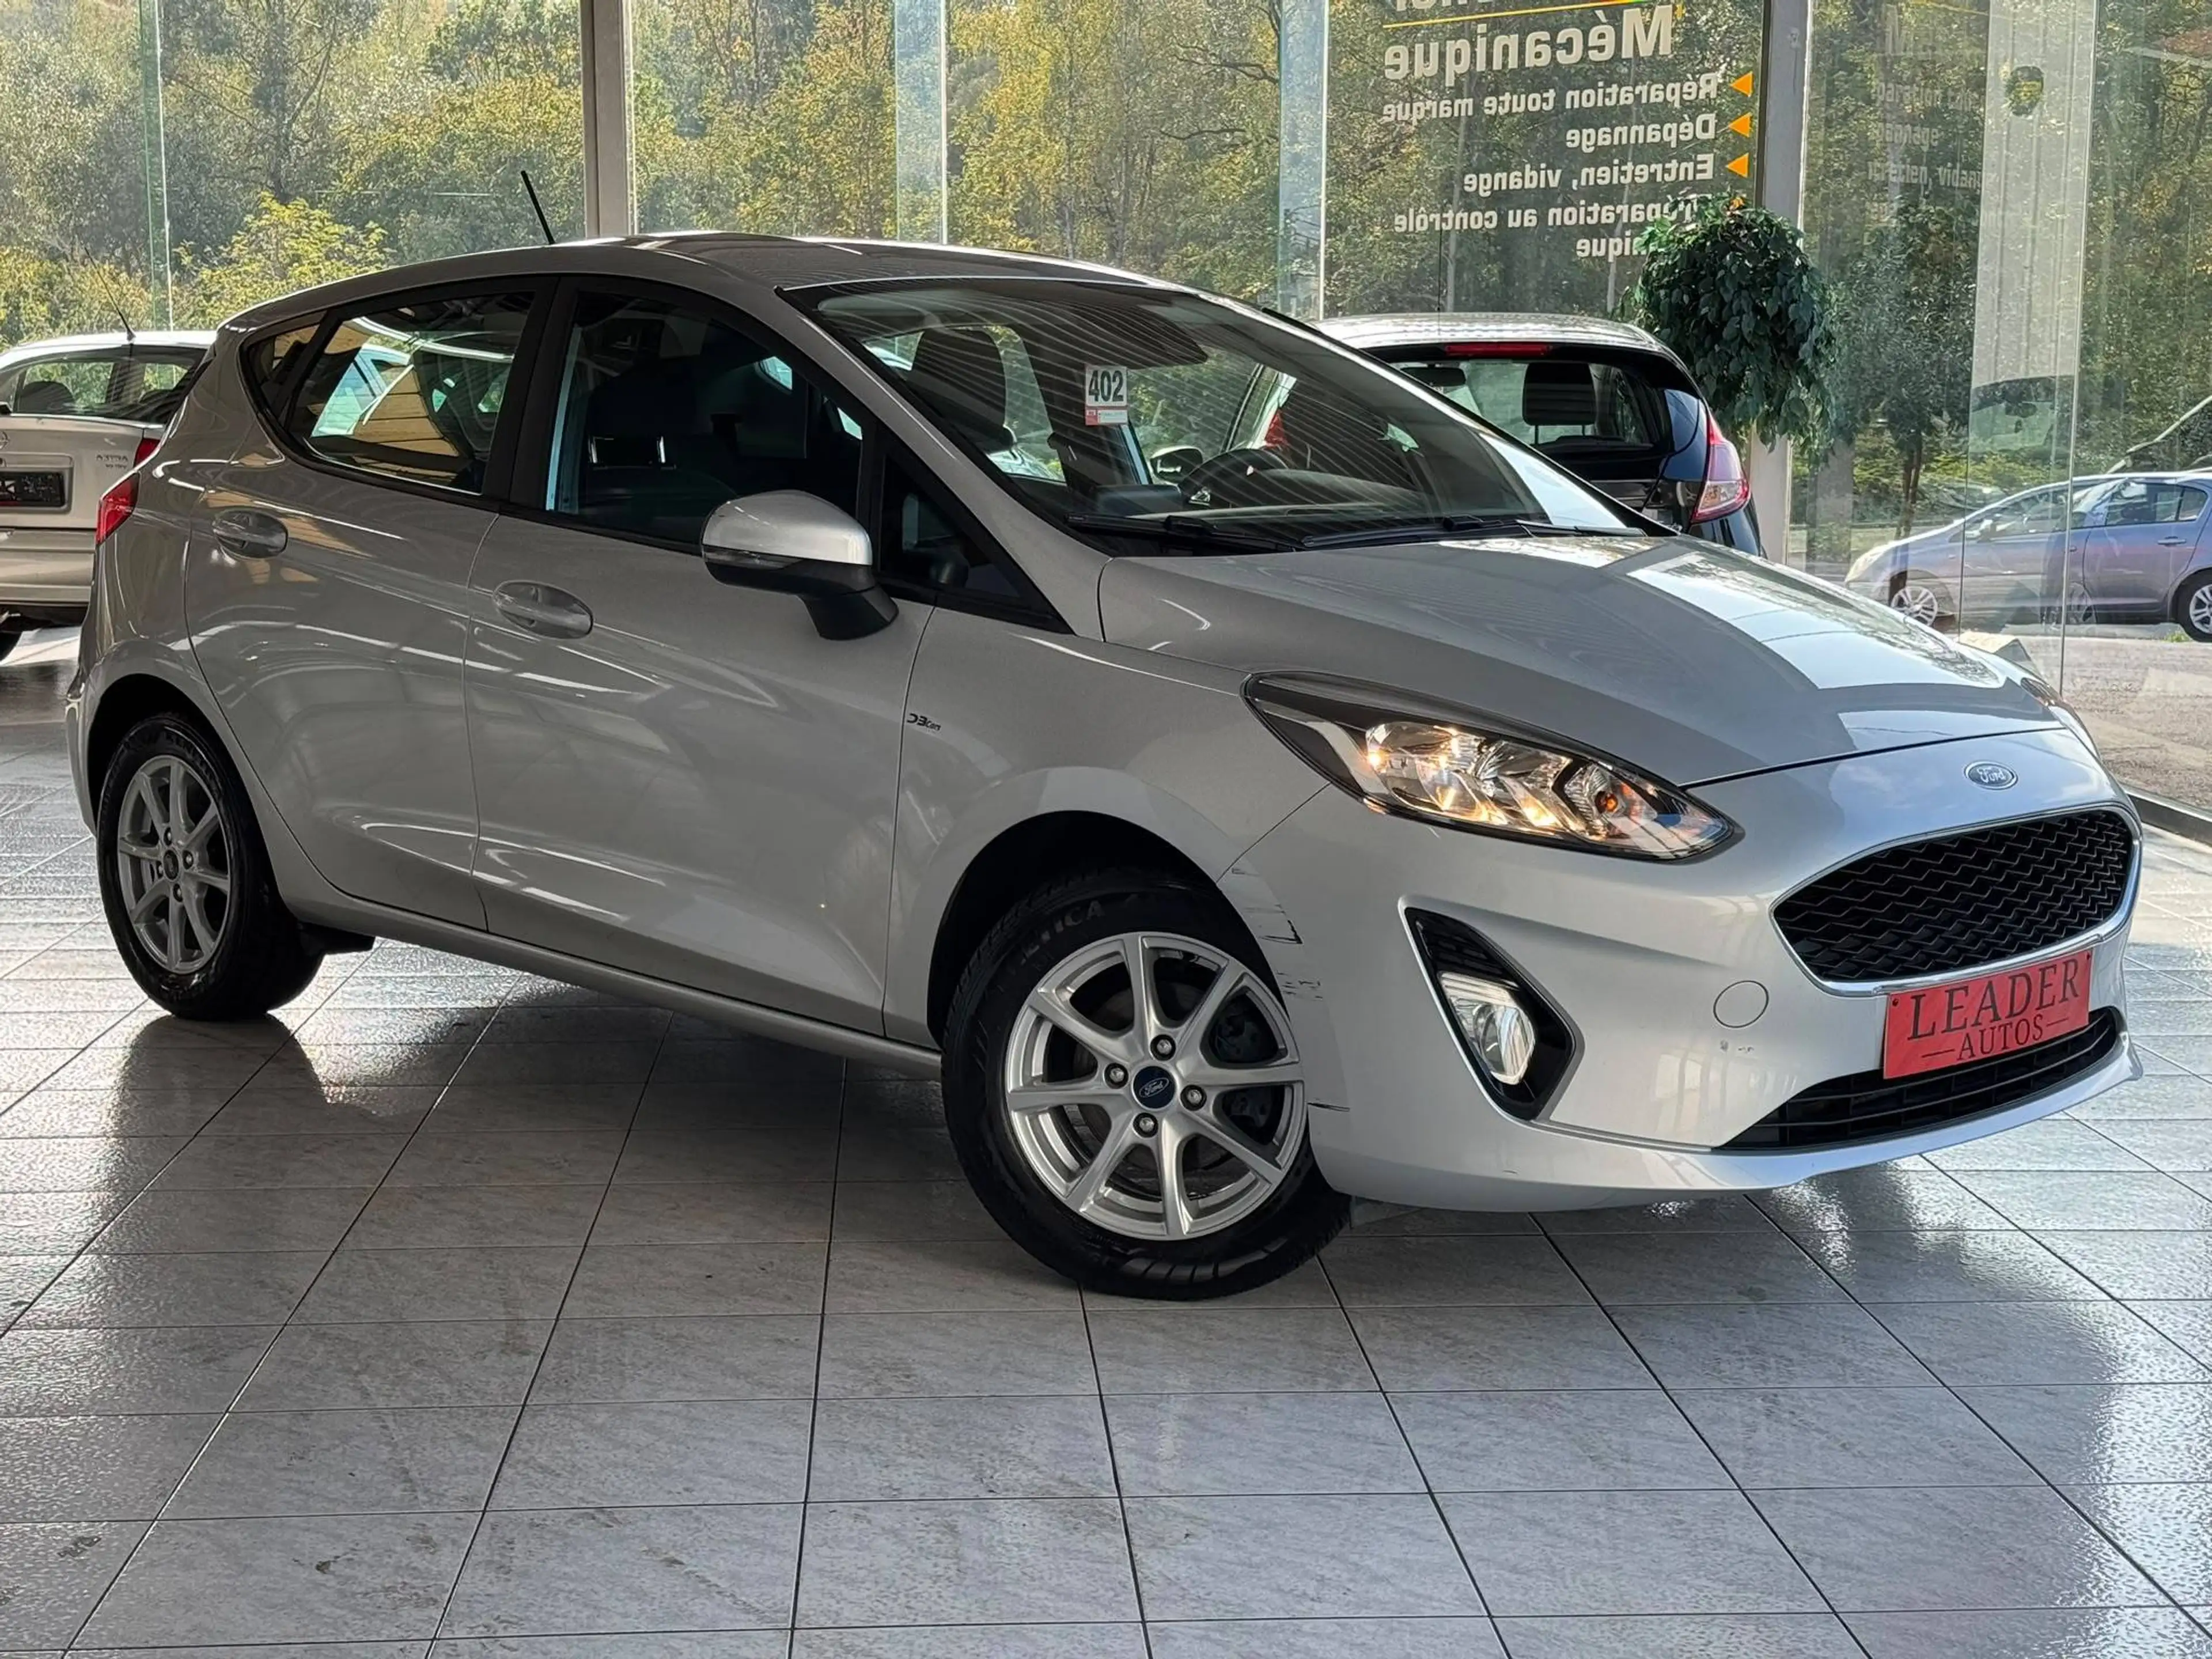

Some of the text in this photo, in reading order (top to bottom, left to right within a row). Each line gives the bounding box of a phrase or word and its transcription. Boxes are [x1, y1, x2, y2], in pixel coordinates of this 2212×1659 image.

[1089, 370, 1124, 402] 402
[1976, 766, 2006, 783] Ford
[1907, 958, 2079, 1041] LEADER
[1957, 1013, 2044, 1061] AUTOS
